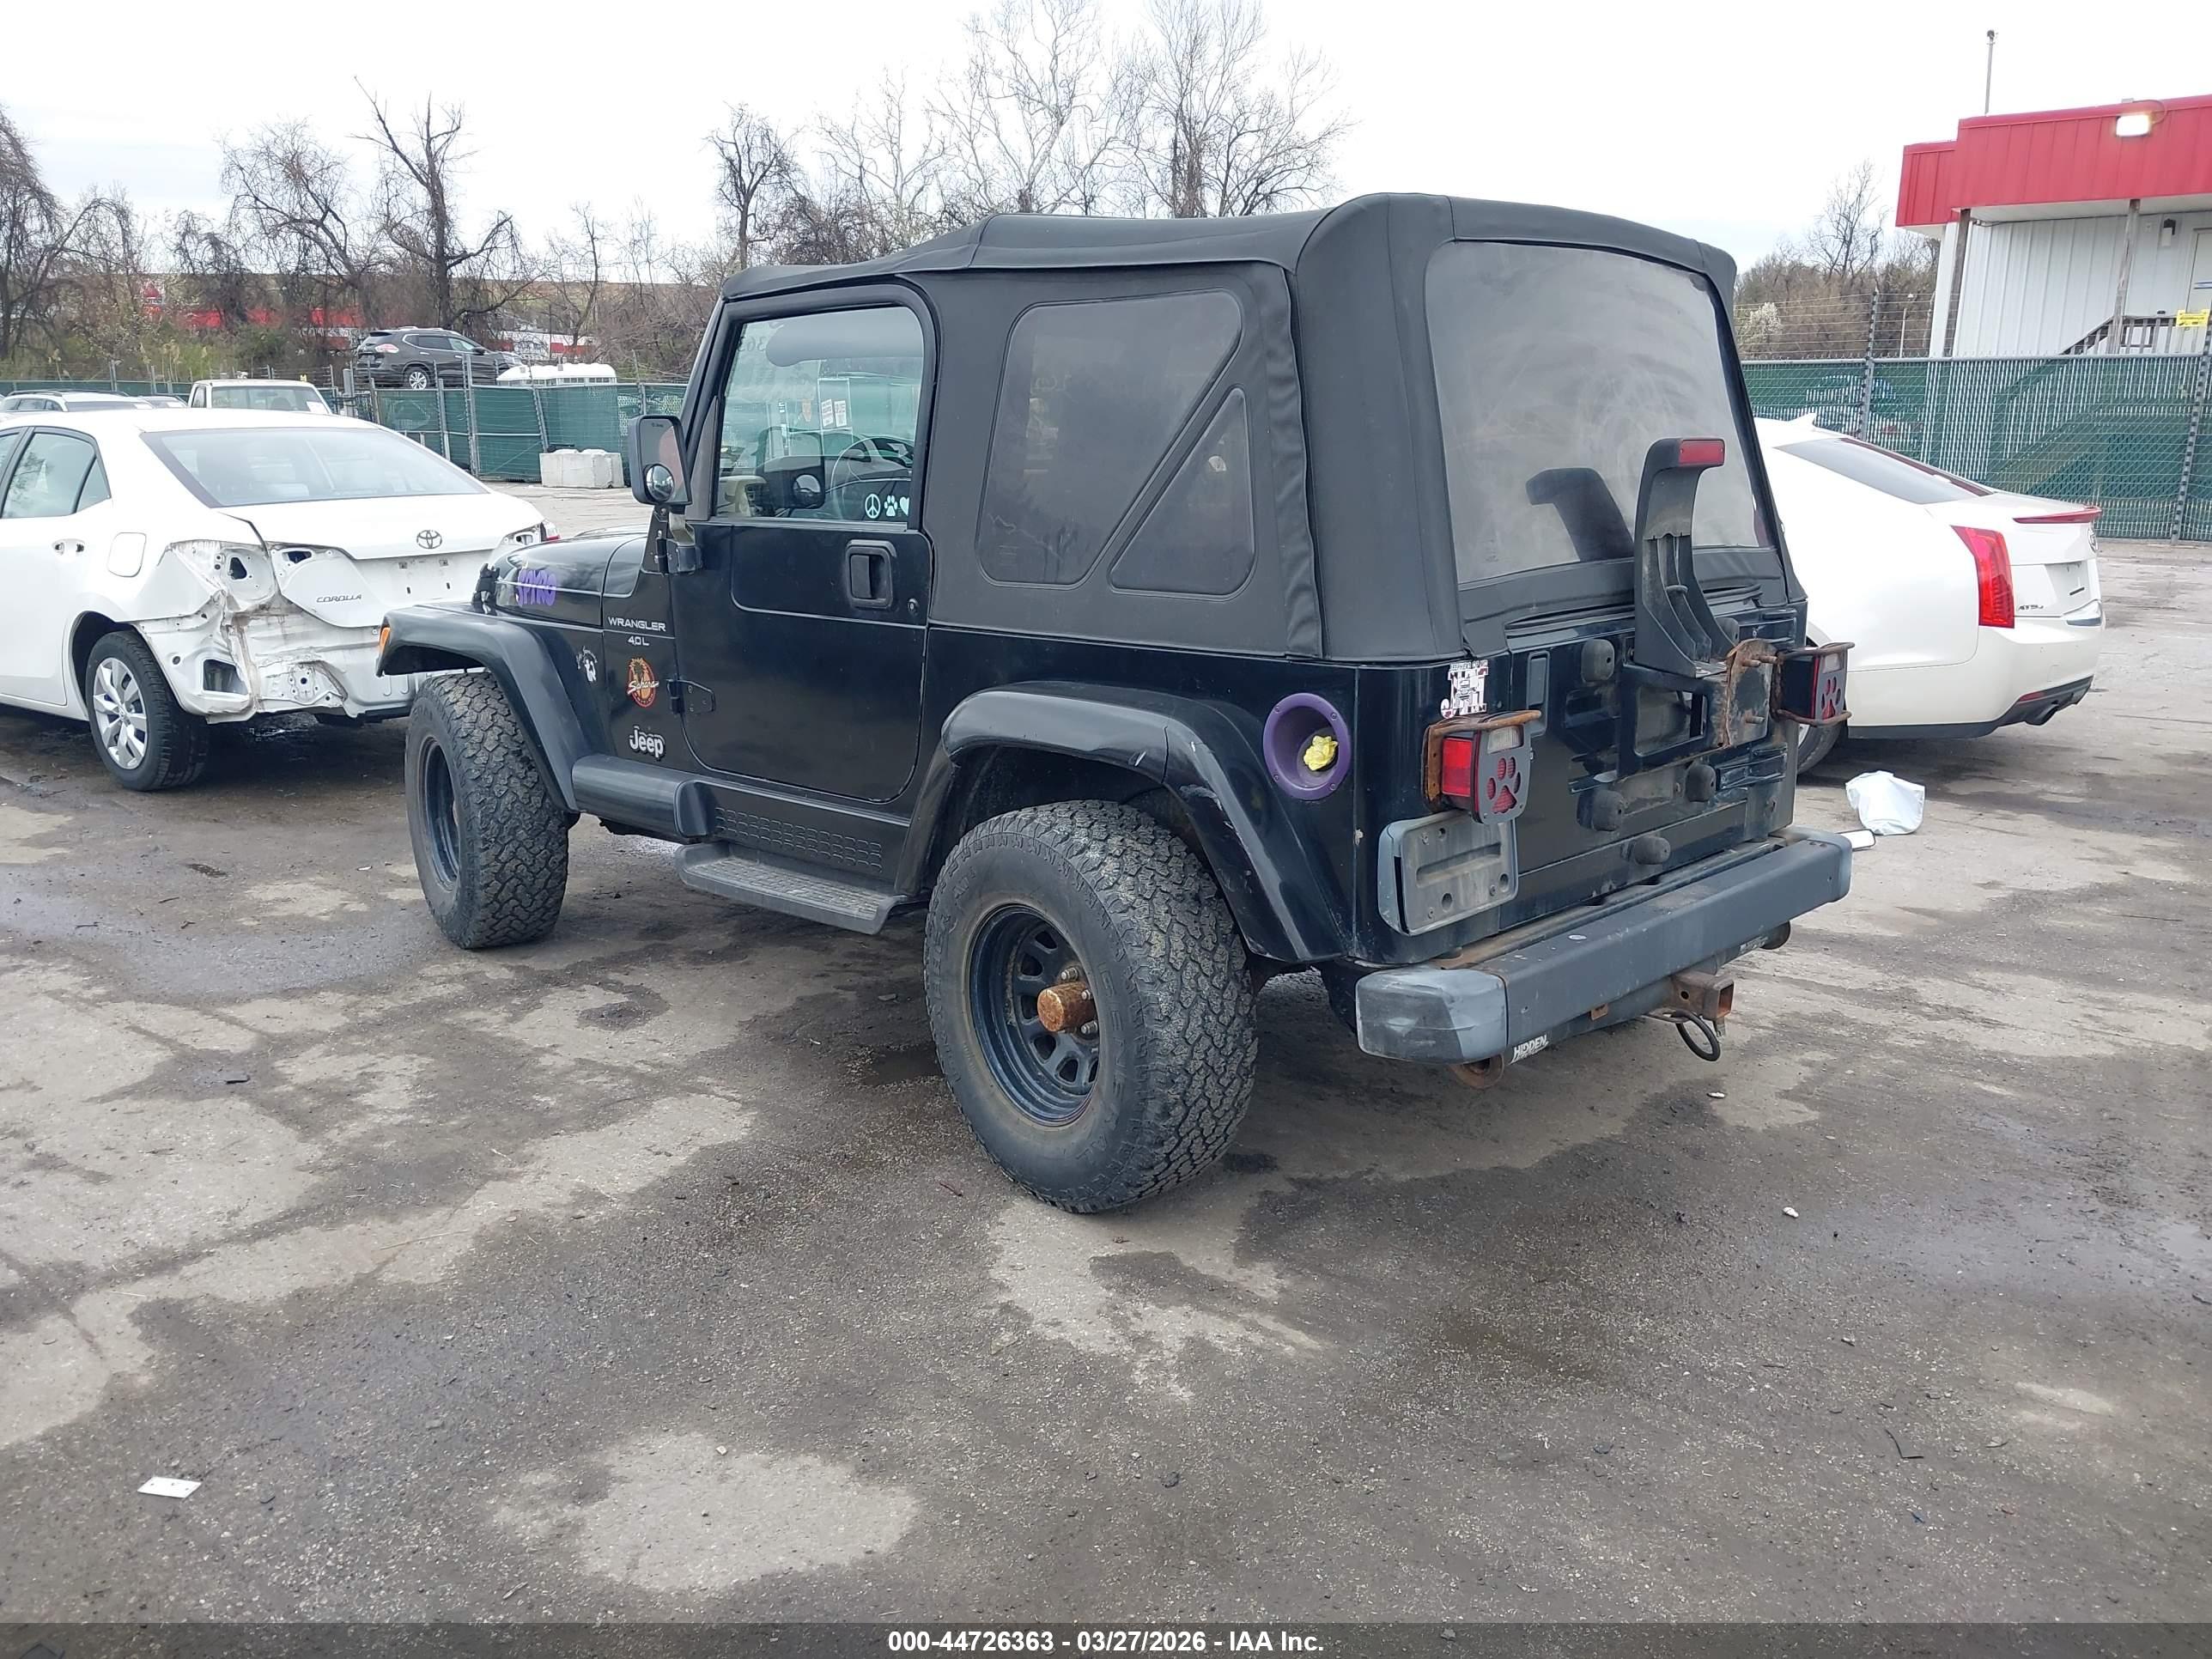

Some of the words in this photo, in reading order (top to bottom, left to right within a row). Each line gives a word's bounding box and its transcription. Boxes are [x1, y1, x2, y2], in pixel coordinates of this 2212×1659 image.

[316, 593, 362, 603] COROLLA
[608, 617, 666, 632] WRANGLER
[627, 678, 659, 695] Sahara
[629, 726, 665, 759] Jeep
[1510, 1034, 1547, 1063] HIDDEN
